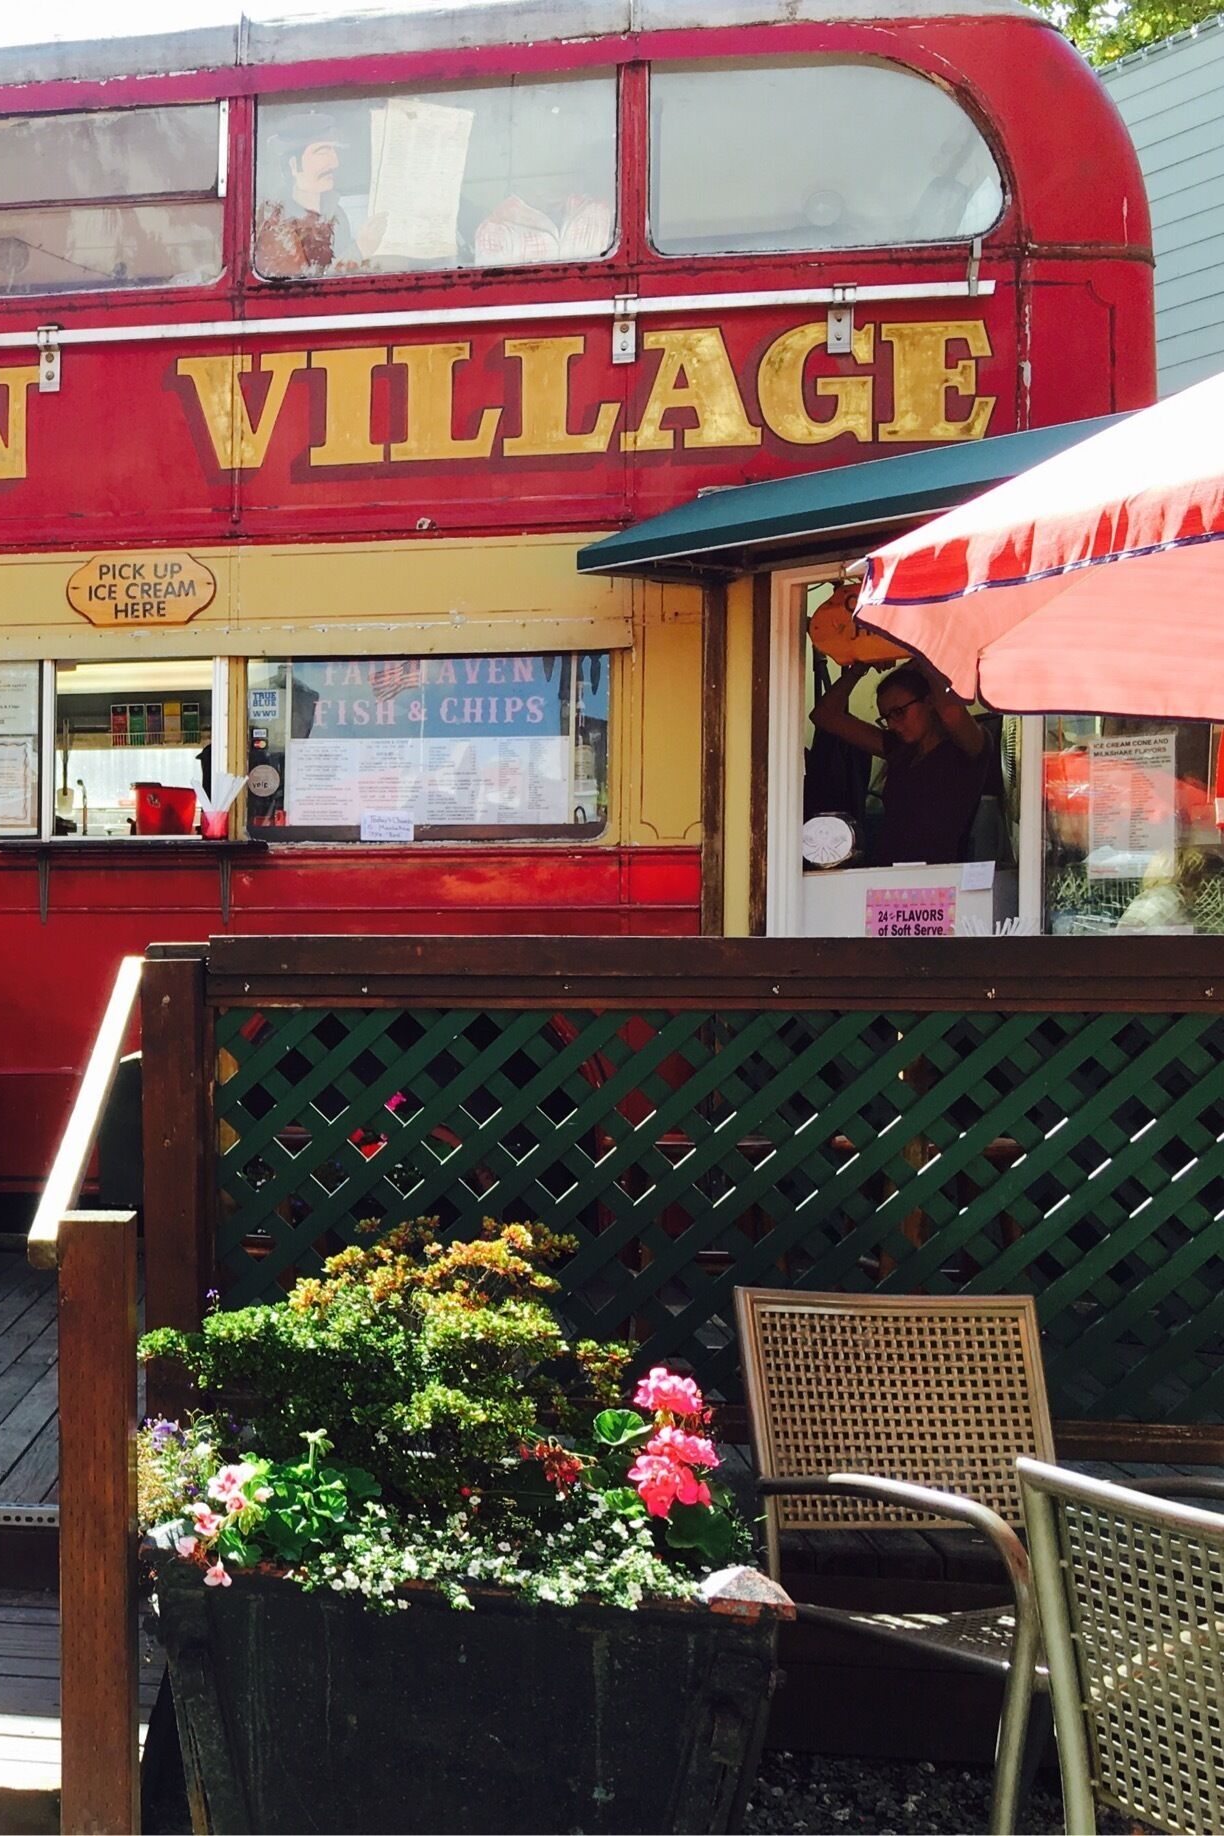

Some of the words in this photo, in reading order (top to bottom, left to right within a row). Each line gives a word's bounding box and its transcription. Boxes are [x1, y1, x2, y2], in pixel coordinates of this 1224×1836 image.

[177, 318, 996, 470] VILLAGE
[99, 563, 145, 580] PICK
[153, 562, 182, 579] UP
[88, 584, 117, 601] ICE
[125, 579, 196, 600] CREAM
[114, 601, 166, 619] HERE
[252, 691, 277, 700] TRUE
[252, 699, 277, 707] BLUE
[313, 699, 396, 727] FISH
[407, 700, 426, 722] &
[440, 696, 545, 724] CHIPS
[1093, 742, 1104, 750] ICE
[1106, 741, 1131, 749] CREAM
[1132, 739, 1152, 747] CONE
[1093, 749, 1132, 758] MILKSHAKE
[878, 910, 888, 923] 24
[896, 909, 944, 922] FLAVORS
[878, 924, 888, 937] of
[890, 923, 912, 936] Soft
[914, 923, 944, 936] Serve
